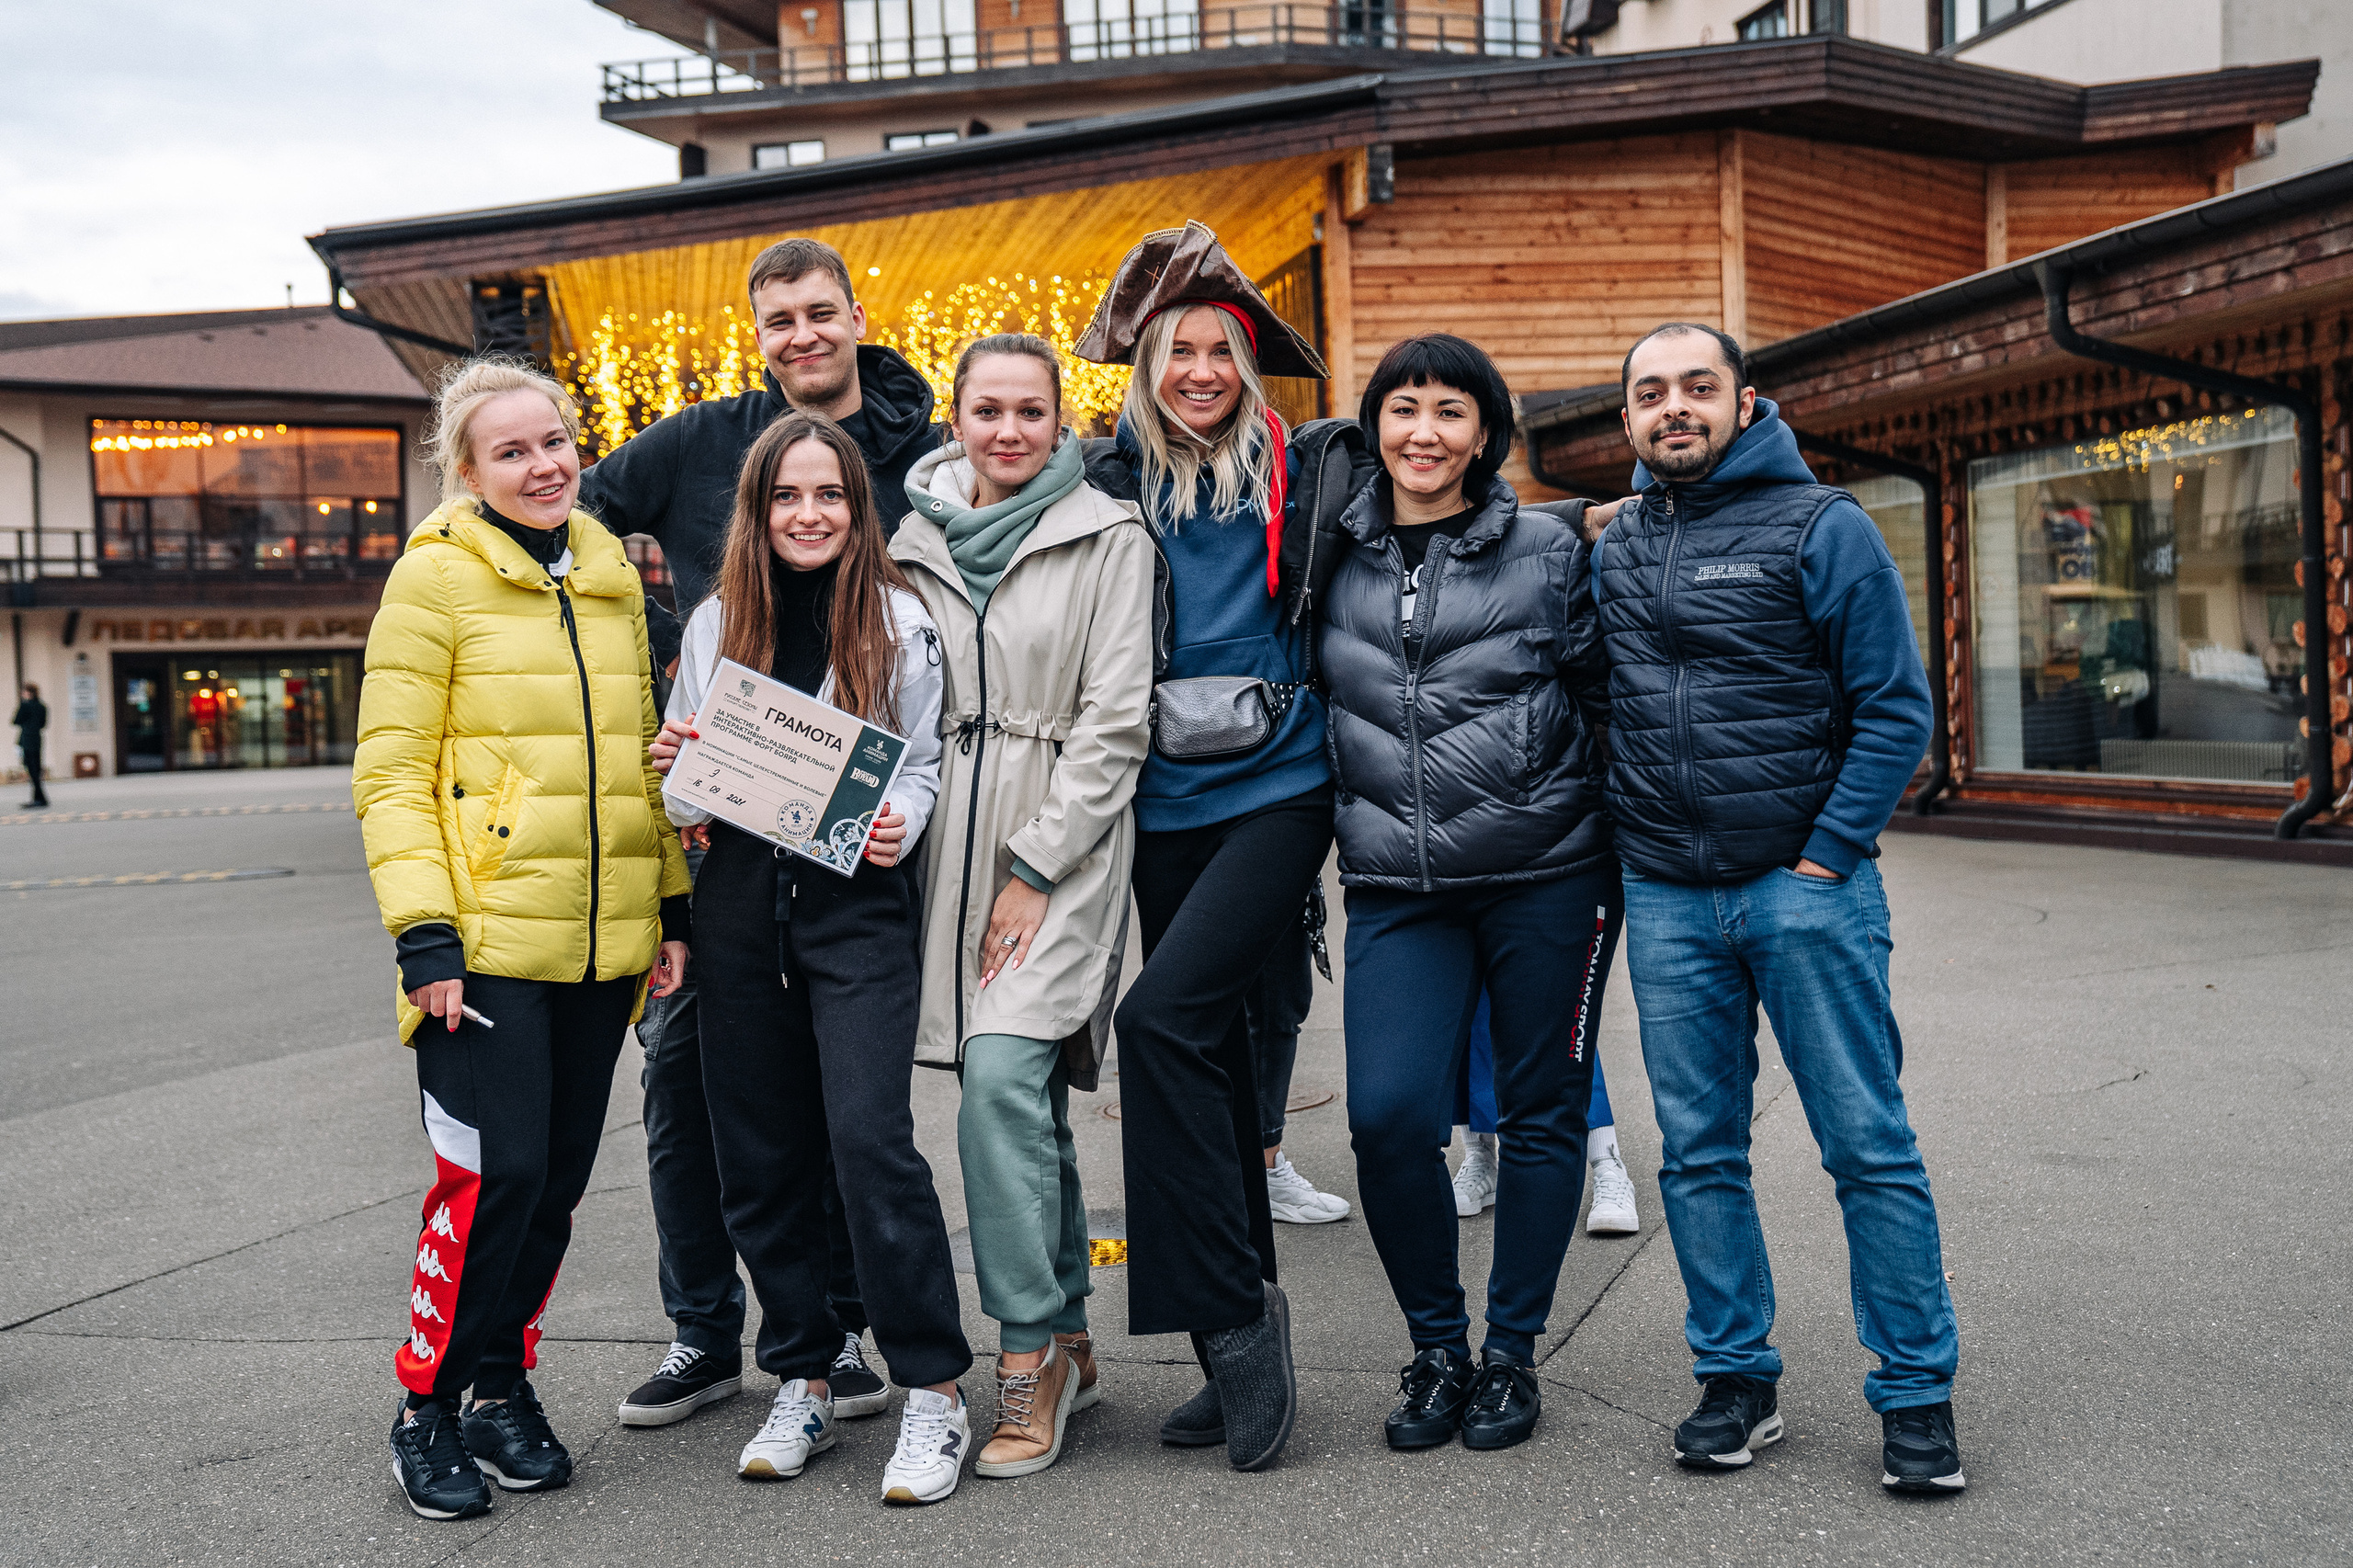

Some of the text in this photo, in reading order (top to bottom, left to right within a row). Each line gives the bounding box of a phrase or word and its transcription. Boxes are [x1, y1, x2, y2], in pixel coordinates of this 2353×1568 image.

[1698, 562, 1760, 575] PHILIP MORRIS
[716, 708, 725, 717] ЗА
[725, 712, 756, 730] УЧАСТИЕ
[765, 707, 842, 753] ГРАМОТА
[710, 721, 798, 765] ПРОГРАММЕ ФОРТ БОЯРД
[713, 714, 835, 773] ИНТЕРАКТИВНО-РАЗВЛЕКАТЕЛЬНОЙ
[697, 751, 755, 779] НАГРАЖДАЕТСЯ КОМАНДА
[706, 742, 735, 758] НОМИНАЦИИ
[753, 763, 800, 787] ЦЕЛЕУСТРЕМЛЕННЫЕ
[692, 778, 703, 788] 16
[709, 785, 721, 794] 09
[726, 793, 747, 806] 2021
[781, 801, 813, 815] КОМАНДА
[781, 823, 813, 836] АНИМАЦИИ
[1568, 1004, 1587, 1062] SPORT
